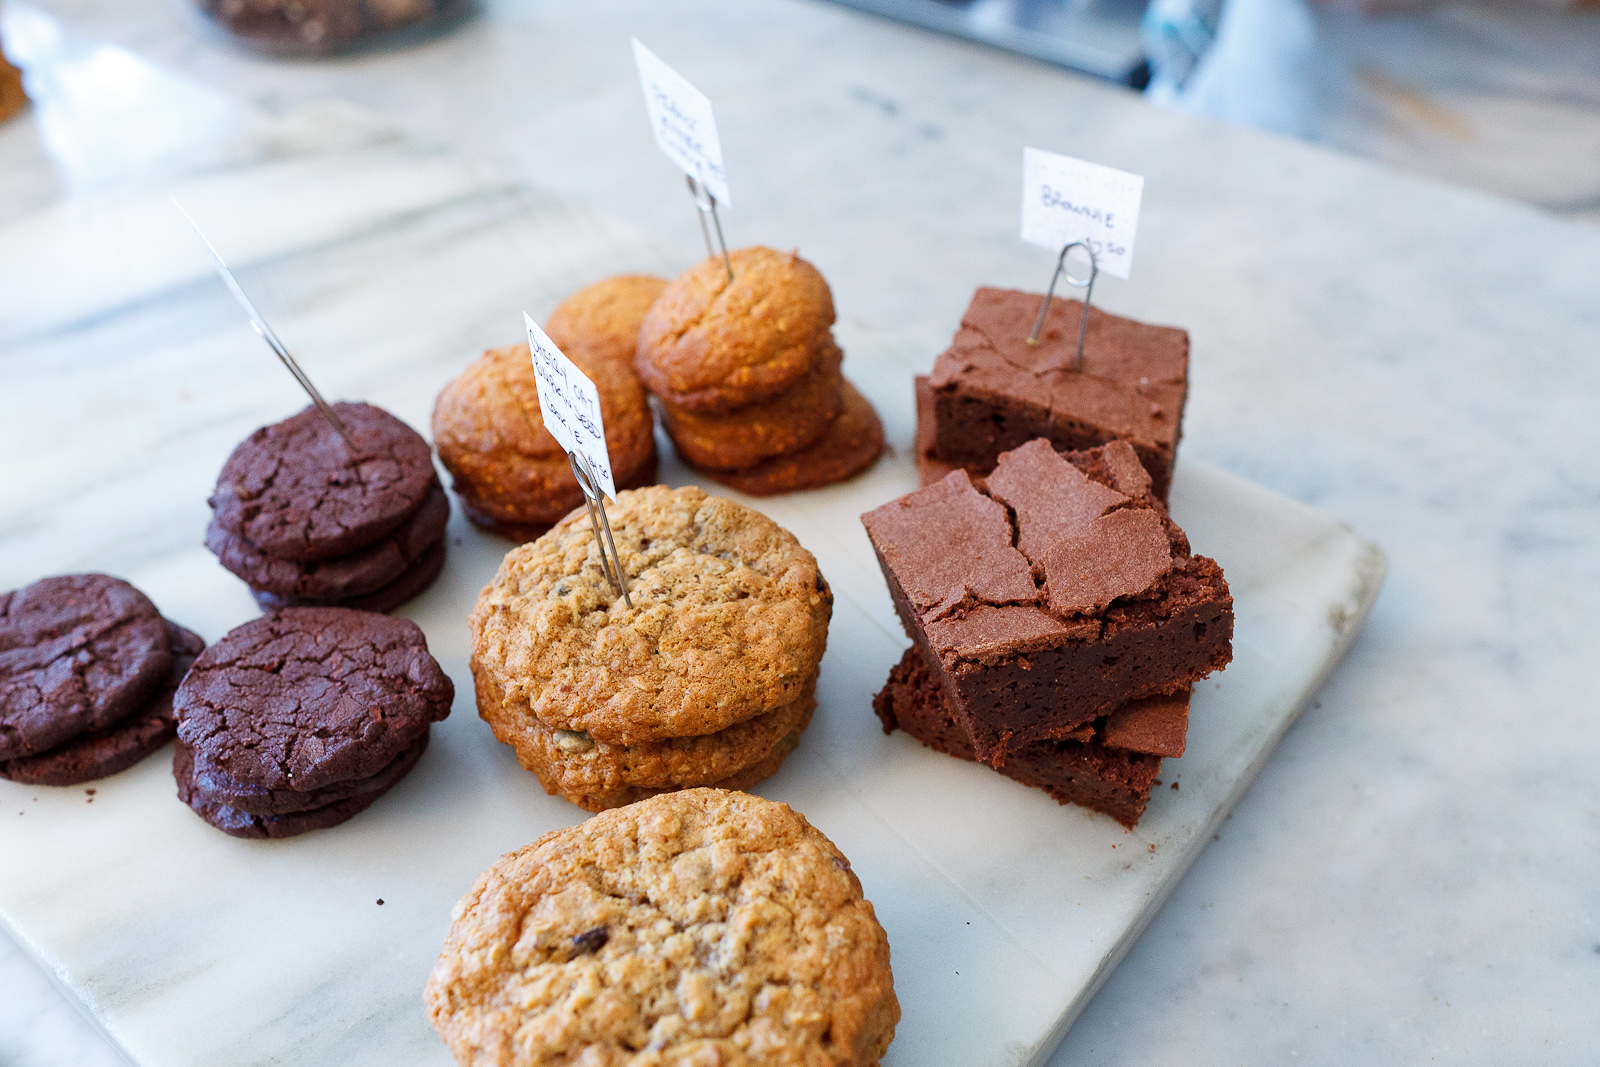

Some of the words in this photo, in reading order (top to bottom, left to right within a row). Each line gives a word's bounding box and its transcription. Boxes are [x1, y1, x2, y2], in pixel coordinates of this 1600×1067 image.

[1041, 184, 1115, 228] BROWNIE
[529, 329, 569, 390] CHERRY
[544, 392, 583, 445] COOKIE
[574, 404, 602, 440] SEED
